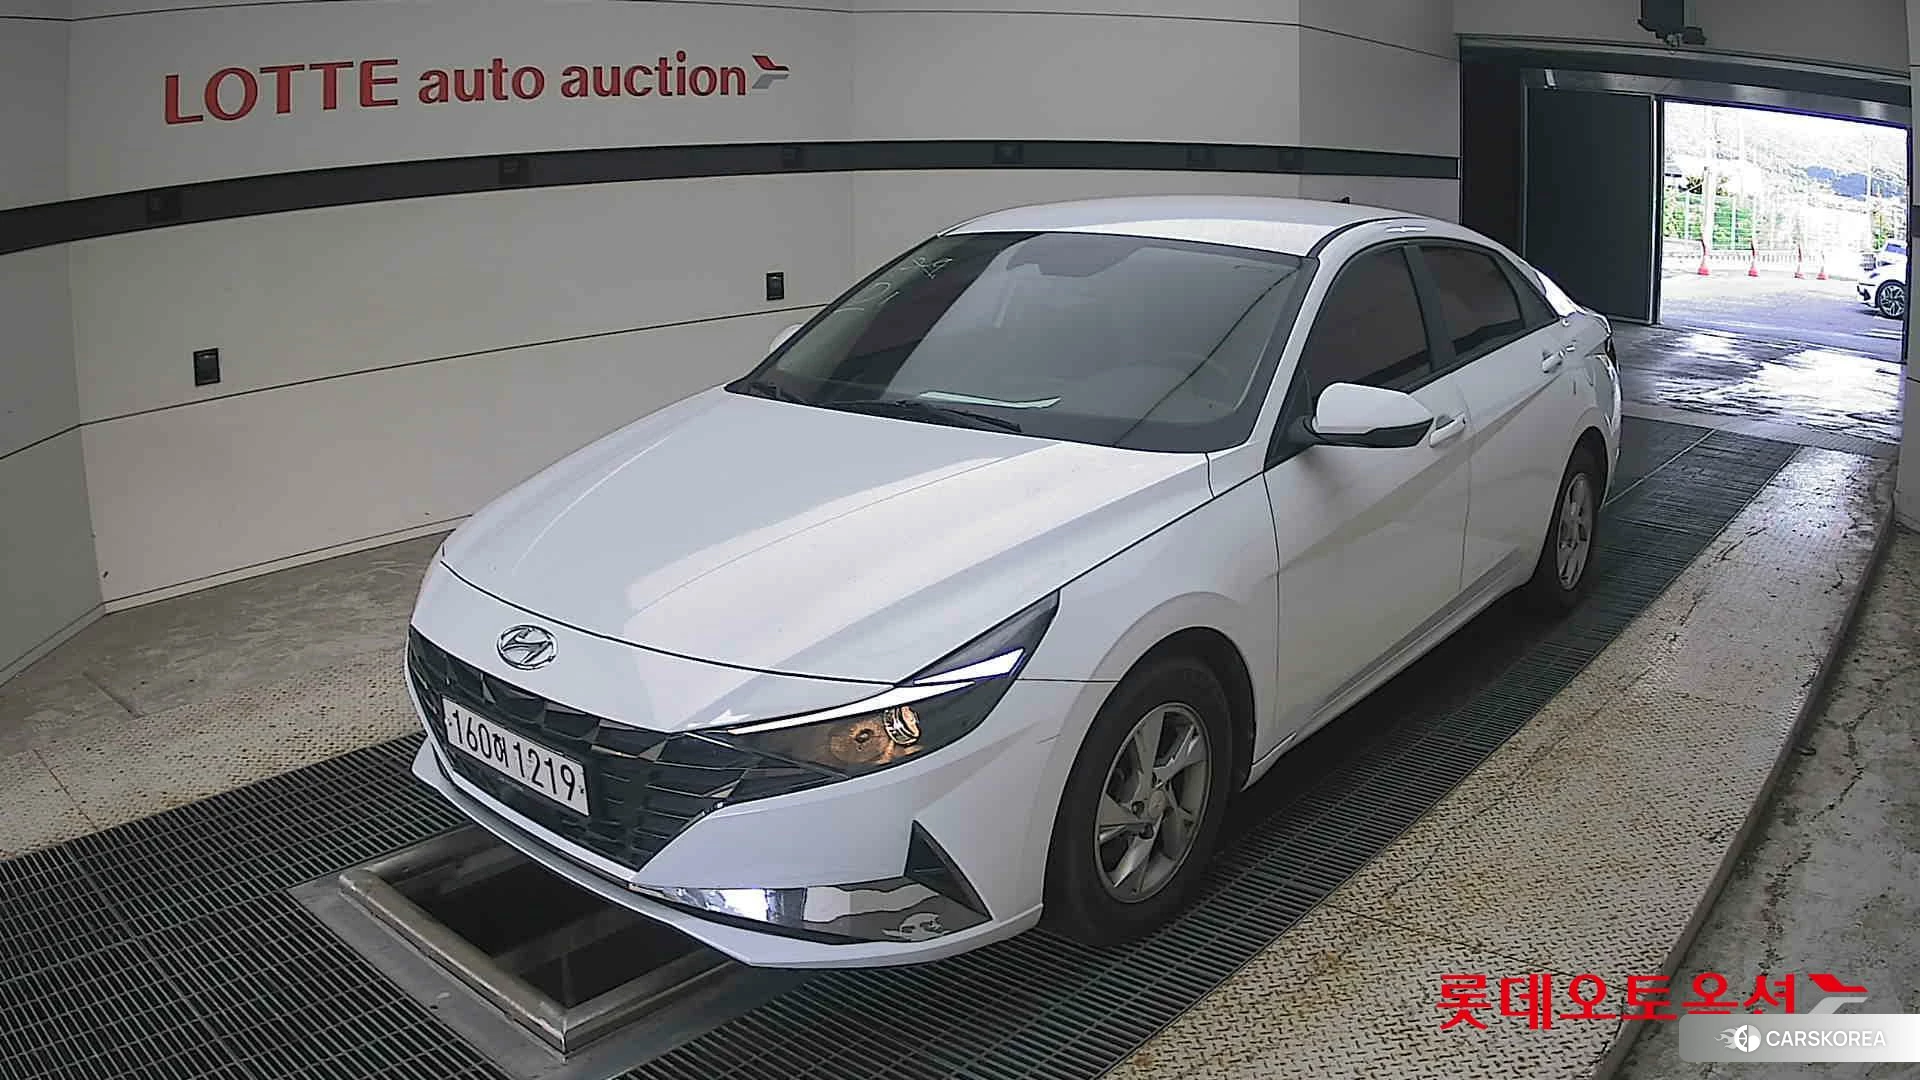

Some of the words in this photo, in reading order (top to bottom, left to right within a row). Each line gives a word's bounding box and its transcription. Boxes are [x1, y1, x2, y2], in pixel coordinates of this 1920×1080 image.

[164, 58, 399, 125] LOTTE
[418, 58, 546, 104] auto
[560, 50, 747, 98] auction
